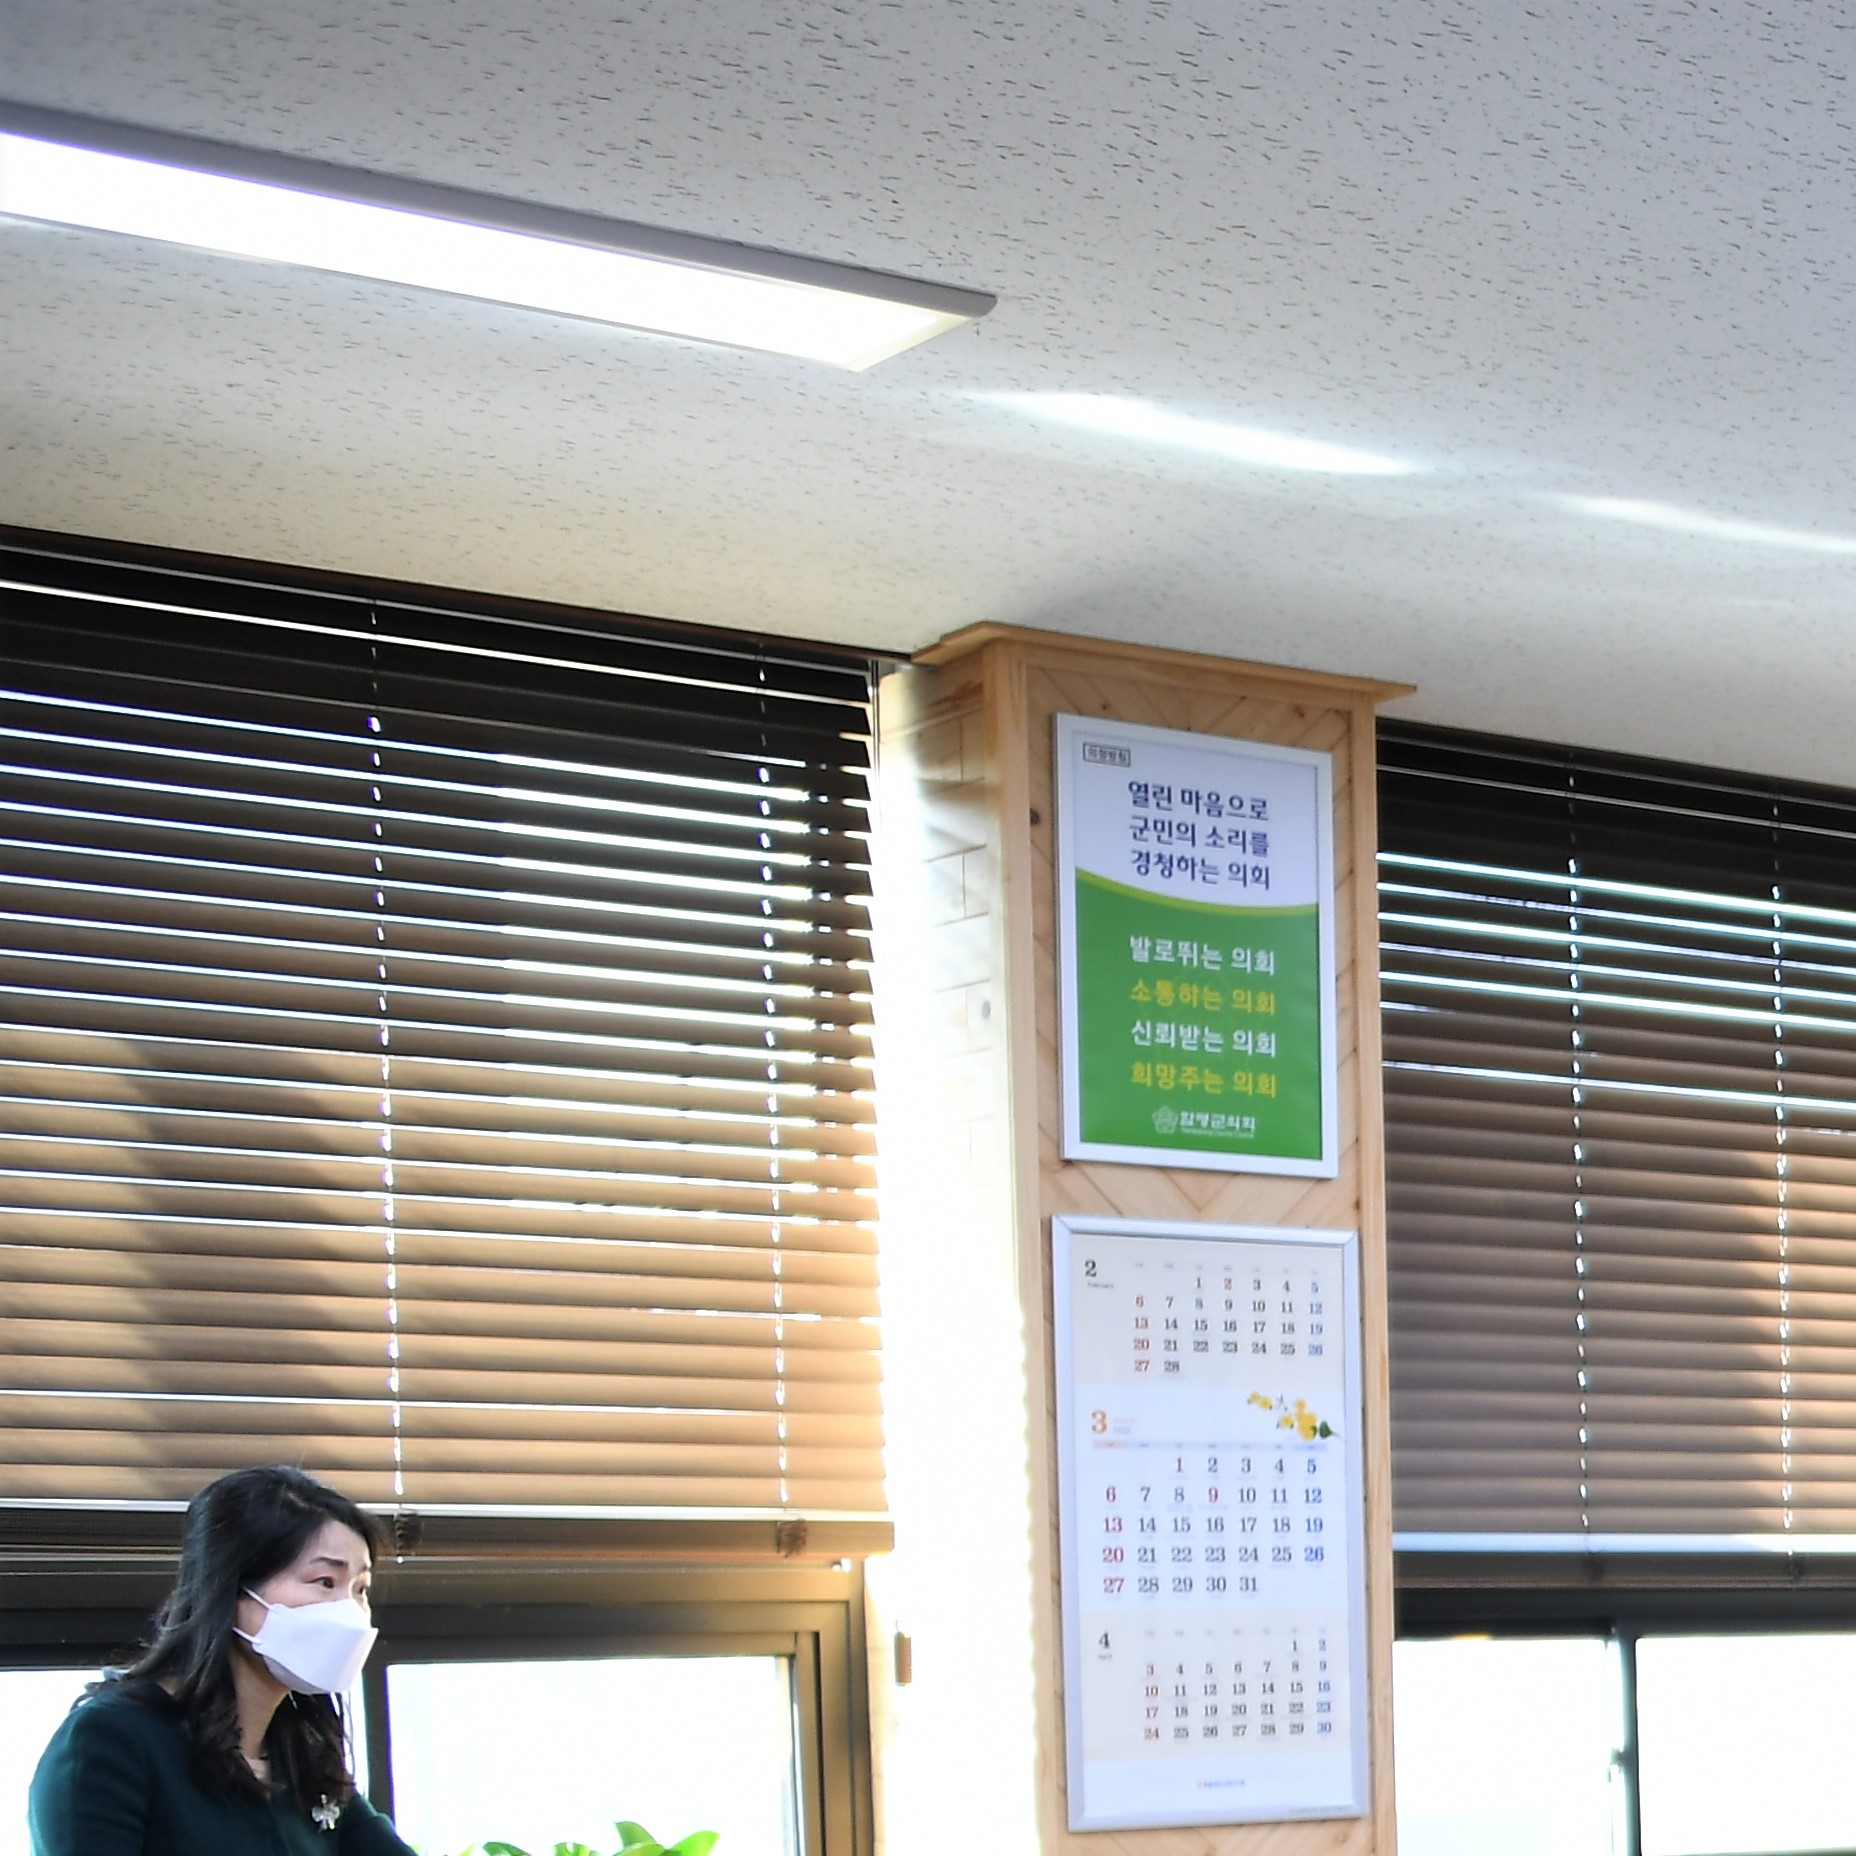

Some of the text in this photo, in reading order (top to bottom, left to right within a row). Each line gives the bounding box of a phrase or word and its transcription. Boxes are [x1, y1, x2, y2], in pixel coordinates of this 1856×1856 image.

[1127, 780, 1269, 821] 열린 마음으로
[1129, 816, 1269, 856] 군민의 소리를
[1132, 851, 1270, 890] 경청하는 의회
[1130, 936, 1275, 975] 발로뛰는 의회
[1131, 979, 1275, 1016] 소통하는 의회
[1132, 1020, 1276, 1057] 신뢰받는 의회
[1132, 1062, 1276, 1097] 희망주는 의회
[1084, 1259, 1097, 1278] 2
[1091, 1409, 1108, 1435] 3
[1176, 1457, 1317, 1475] 1 2 3 4 5
[1105, 1486, 1323, 1504] 6 7 8 9 10 11 12
[1104, 1516, 1324, 1533] 13 14 15 16 17 18 19
[1102, 1546, 1325, 1564] 20 21 22 23 24 25 26
[1103, 1576, 1257, 1594] 27 28 29 30 31
[1098, 1632, 1110, 1649] 4
